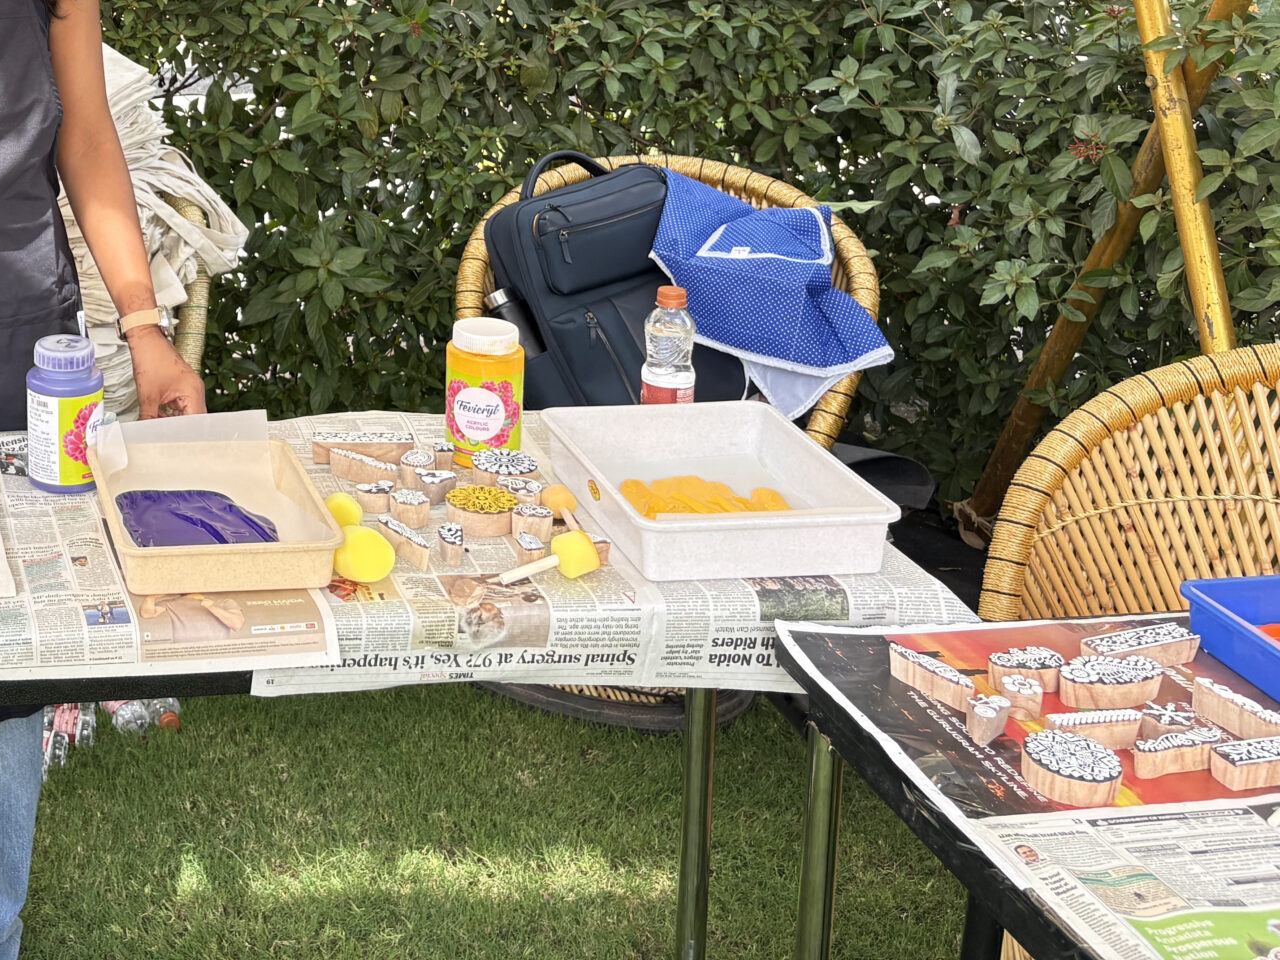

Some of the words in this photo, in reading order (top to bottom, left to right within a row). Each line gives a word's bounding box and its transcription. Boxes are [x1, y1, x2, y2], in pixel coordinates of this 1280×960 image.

[457, 400, 500, 417] Fevicryl
[712, 637, 757, 650] Riders
[404, 653, 425, 669] it's
[430, 652, 462, 668] Yes,
[466, 654, 493, 668] 97?
[496, 653, 513, 665] at
[517, 650, 581, 665] surgery
[584, 650, 637, 667] Spinal
[708, 653, 752, 667] Noida
[756, 653, 773, 666] To
[420, 671, 447, 681] Special
[448, 672, 474, 680] TIMES
[907, 691, 929, 708] THE
[926, 709, 985, 759] GURUGRAM
[1144, 920, 1215, 935] Progressive
[1163, 937, 1238, 953] Prosperous
